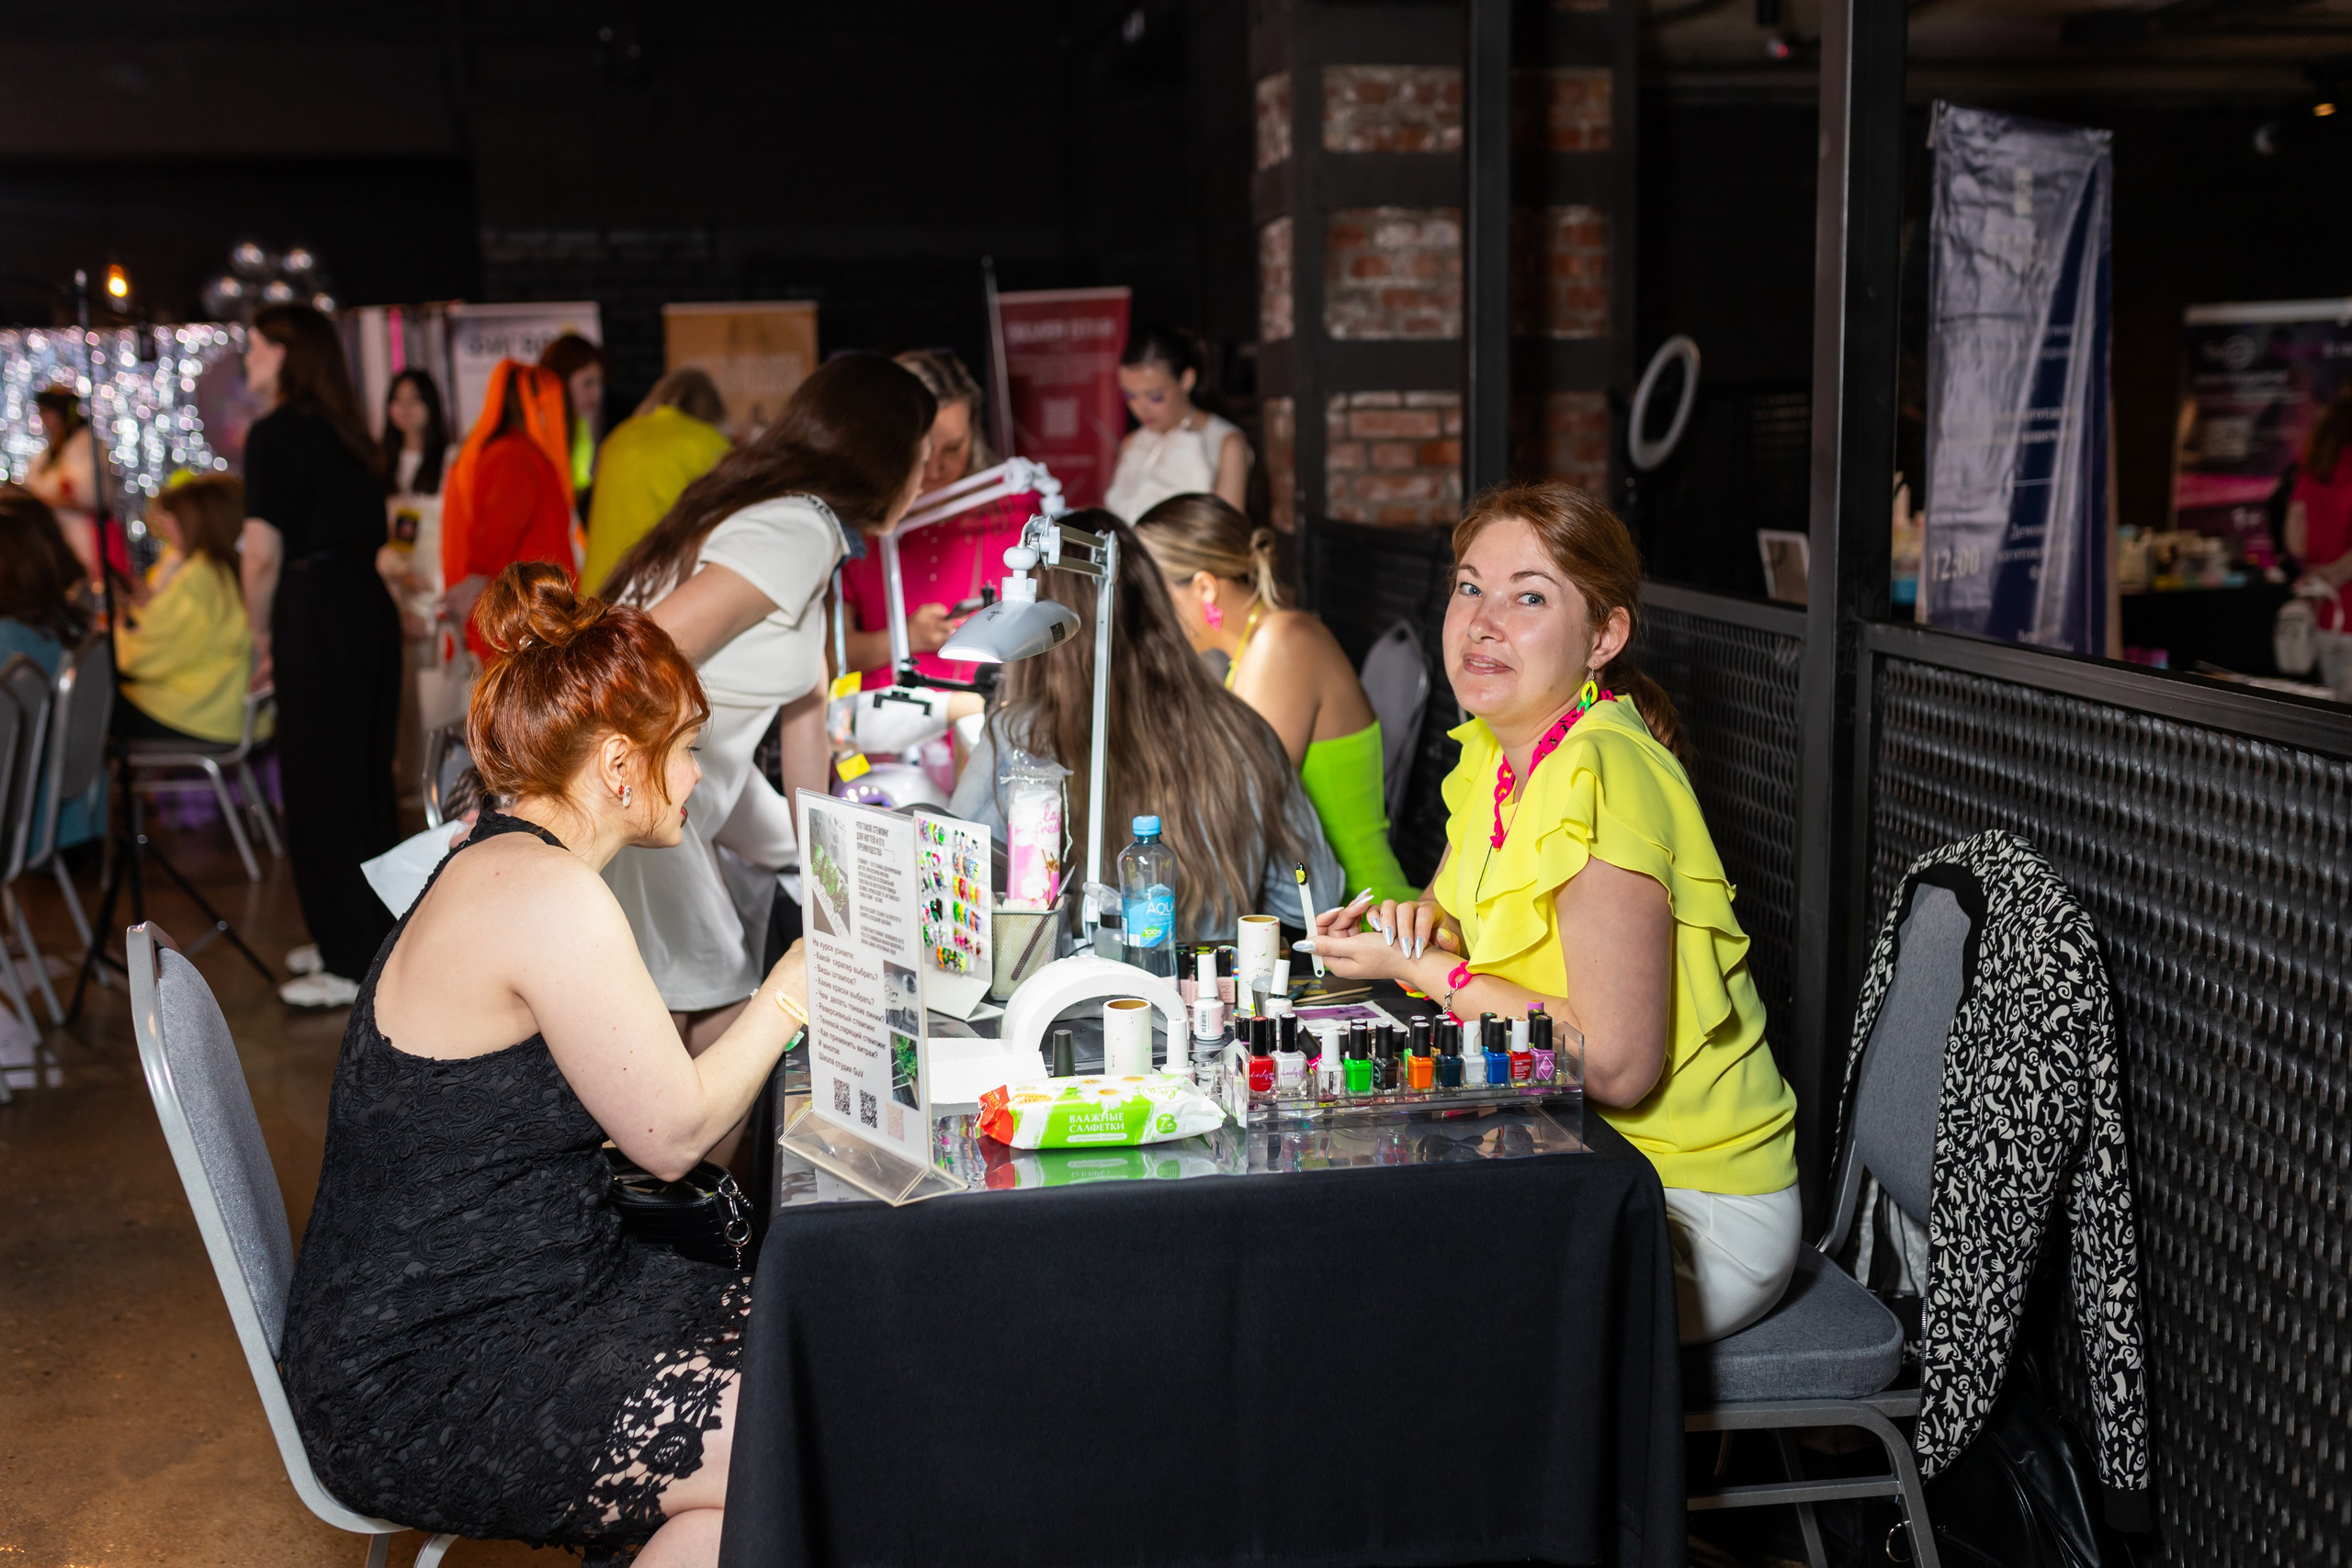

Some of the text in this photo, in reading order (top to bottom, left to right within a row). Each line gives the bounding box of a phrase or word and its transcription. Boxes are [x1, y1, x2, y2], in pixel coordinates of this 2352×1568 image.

[1932, 546, 1980, 581] 12:00
[1146, 901, 1174, 916] AQU
[820, 942, 833, 953] курсе
[834, 947, 854, 960] узнаете:
[816, 952, 878, 981] Какой скрапер выбрать?
[817, 964, 831, 976] Виды
[818, 976, 831, 989] Какие
[832, 984, 849, 996] краски
[850, 991, 875, 1006] выбрать?
[819, 989, 828, 1000] Чем
[831, 996, 847, 1009] делать
[848, 1003, 865, 1016] тонкие
[819, 1001, 876, 1032] Реверсивный стемпинг
[820, 1027, 878, 1059] Как применить витраж?
[822, 1042, 840, 1055] многое
[819, 1051, 834, 1066] Школа
[835, 1059, 853, 1073] студия
[1069, 1112, 1125, 1123] ВЛАЖНЫЕ
[1069, 1122, 1125, 1133] САЛФЕТКИ
[1160, 1116, 1173, 1127] 72
